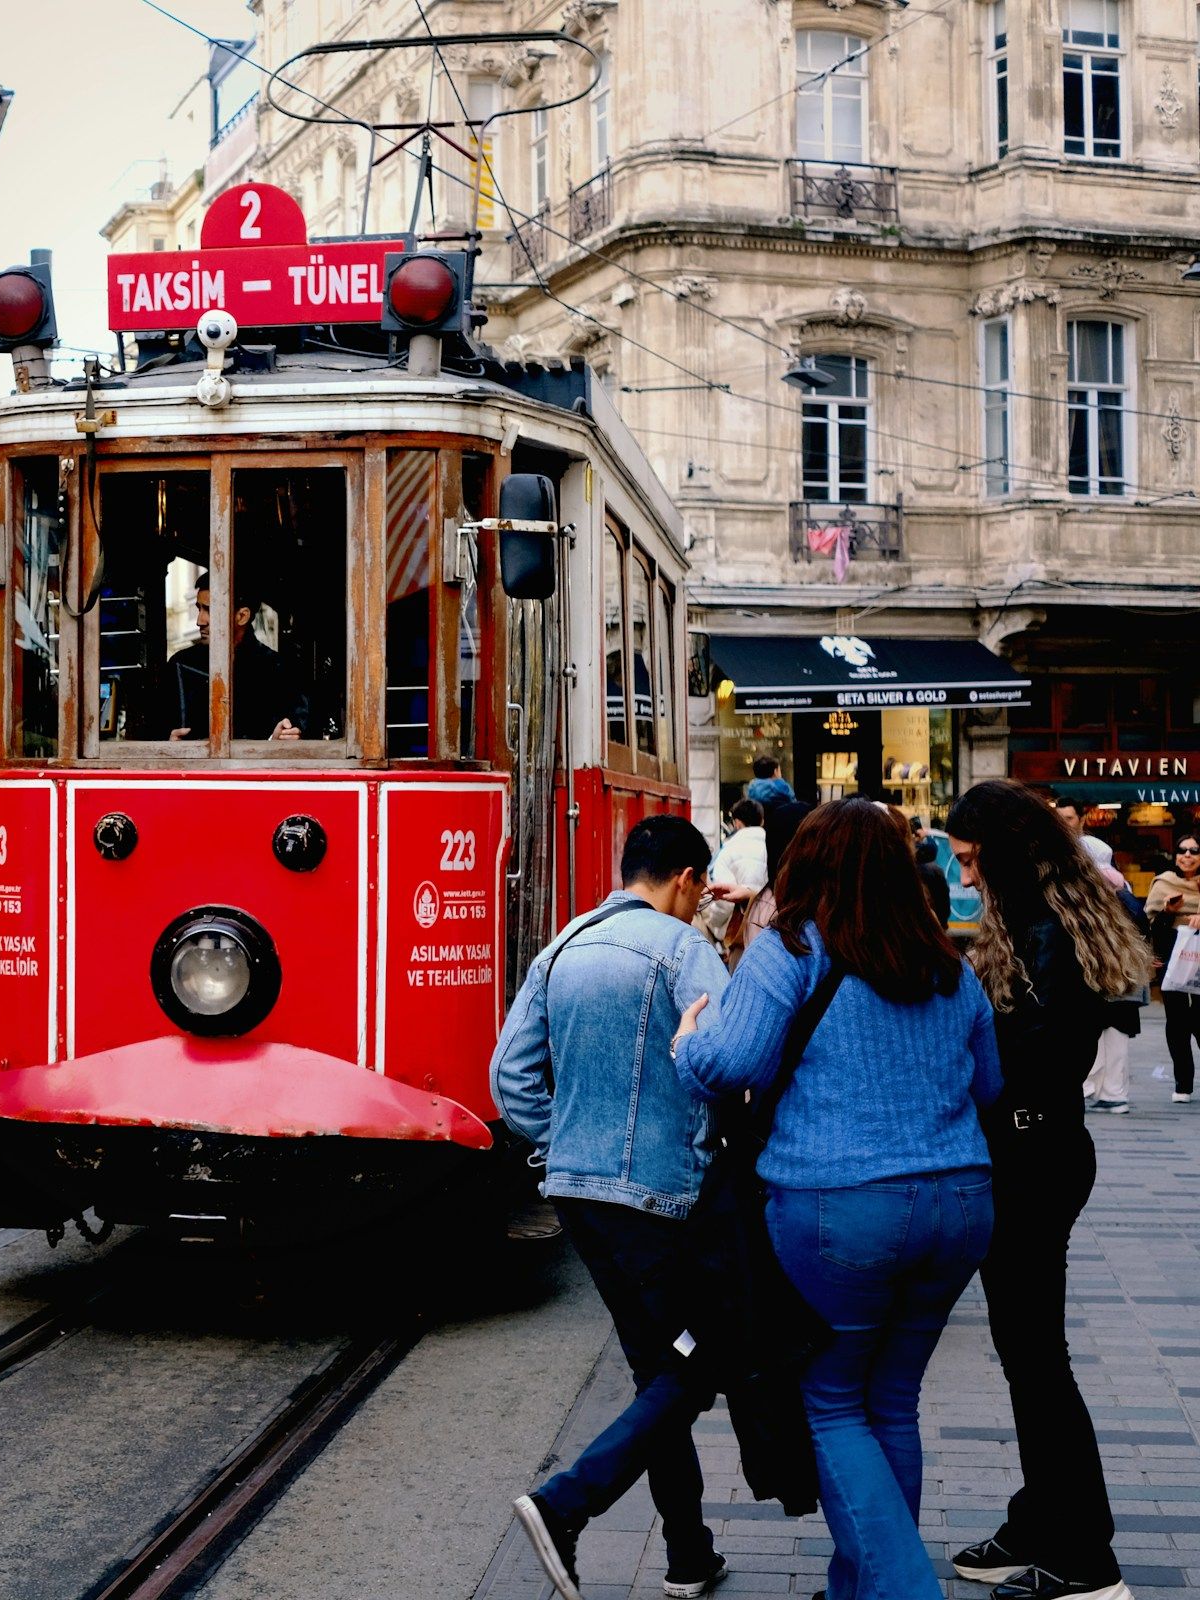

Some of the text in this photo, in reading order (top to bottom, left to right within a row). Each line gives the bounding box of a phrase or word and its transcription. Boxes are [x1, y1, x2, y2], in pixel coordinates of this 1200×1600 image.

[240, 190, 261, 239] 2
[117, 260, 225, 312] TAKSİM
[288, 255, 384, 305] TÜNEL
[837, 692, 865, 705] SETA
[867, 691, 904, 705] SILVER
[906, 691, 915, 703] &
[916, 690, 947, 703] GOLD
[440, 829, 476, 871] 223
[3, 900, 22, 914] 153
[443, 905, 486, 920] ALO 153
[410, 943, 491, 962] ASILMAK YASAK
[407, 963, 492, 987] VE TEHLİKELİDİR
